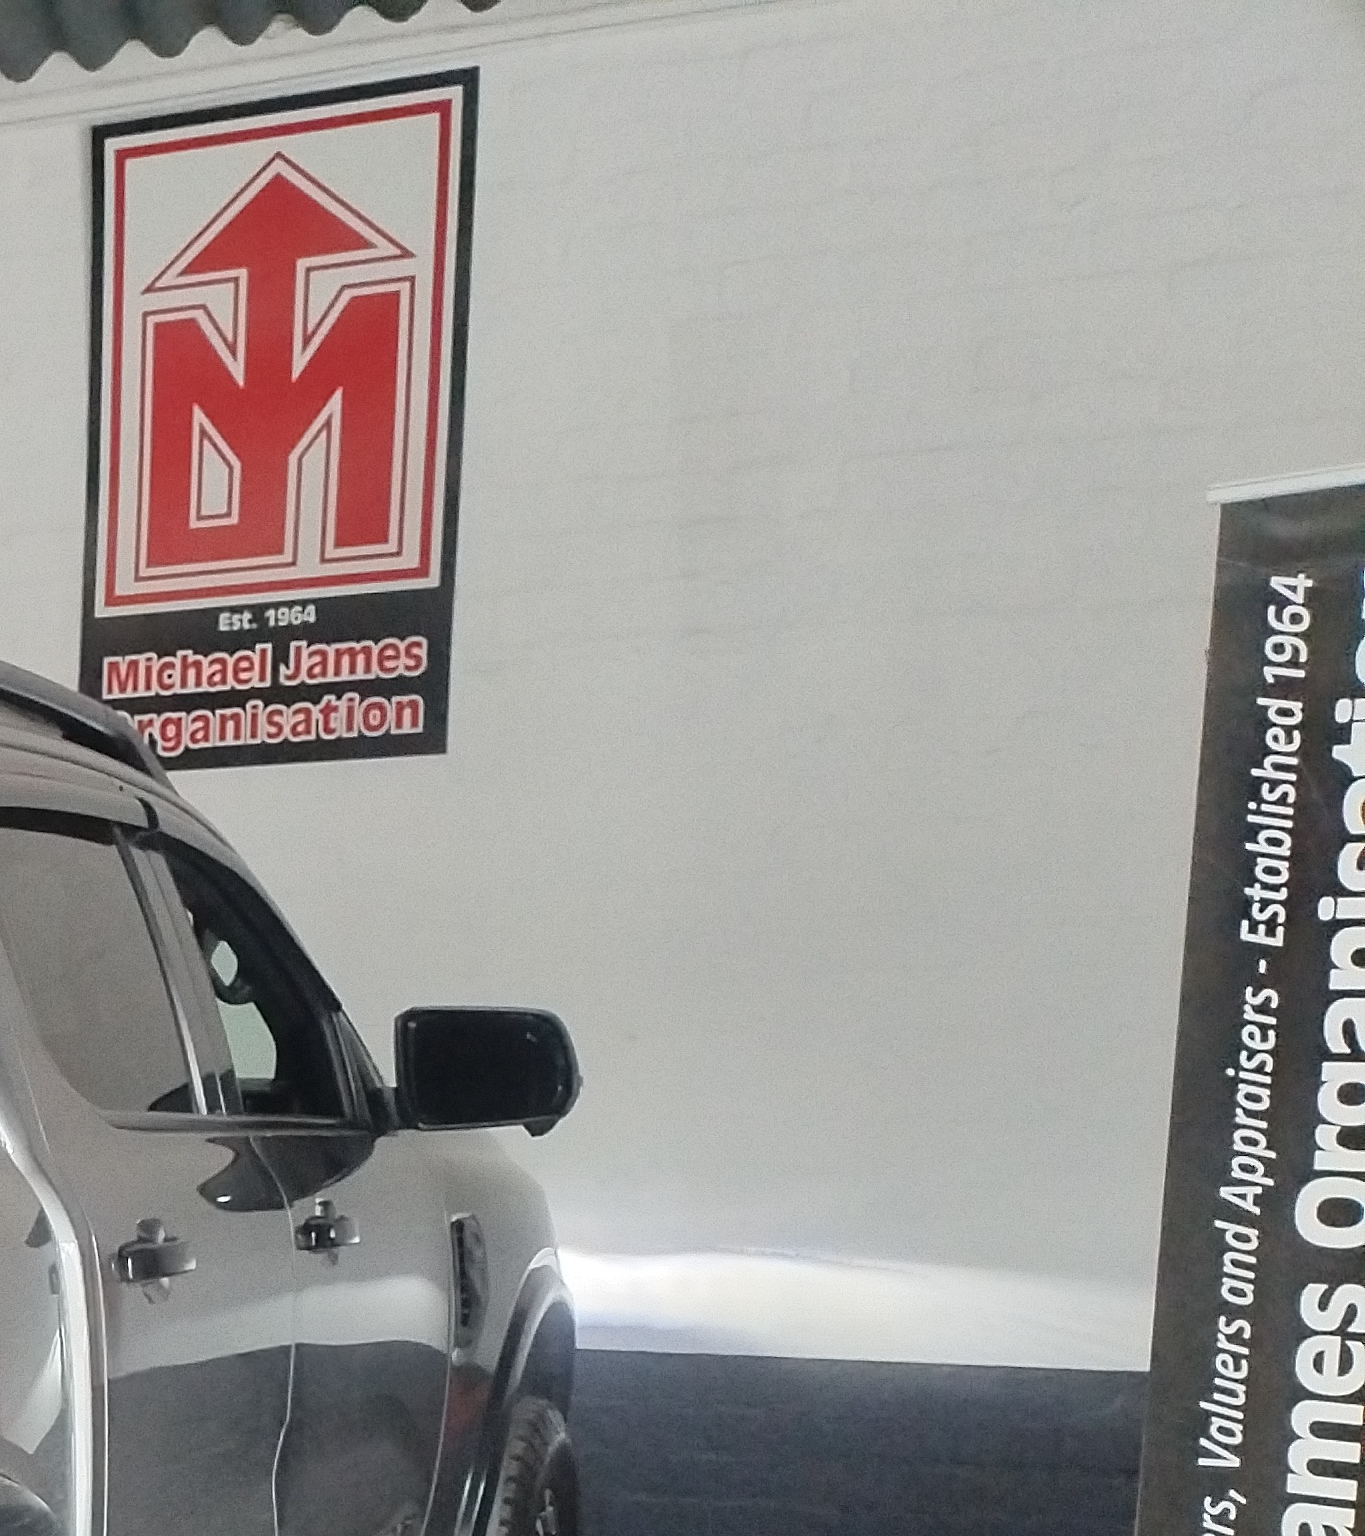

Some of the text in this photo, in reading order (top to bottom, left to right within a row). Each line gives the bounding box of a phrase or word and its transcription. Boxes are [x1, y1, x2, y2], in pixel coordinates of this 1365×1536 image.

[218, 604, 317, 632] Est. 1964
[1262, 572, 1314, 684] 1964
[101, 636, 428, 700] Michael James
[121, 692, 424, 757] rganisation
[1239, 697, 1304, 948] Established
[1218, 985, 1279, 1216] Appraisers
[1213, 1219, 1260, 1306] and
[1197, 1314, 1252, 1469] Valuers
